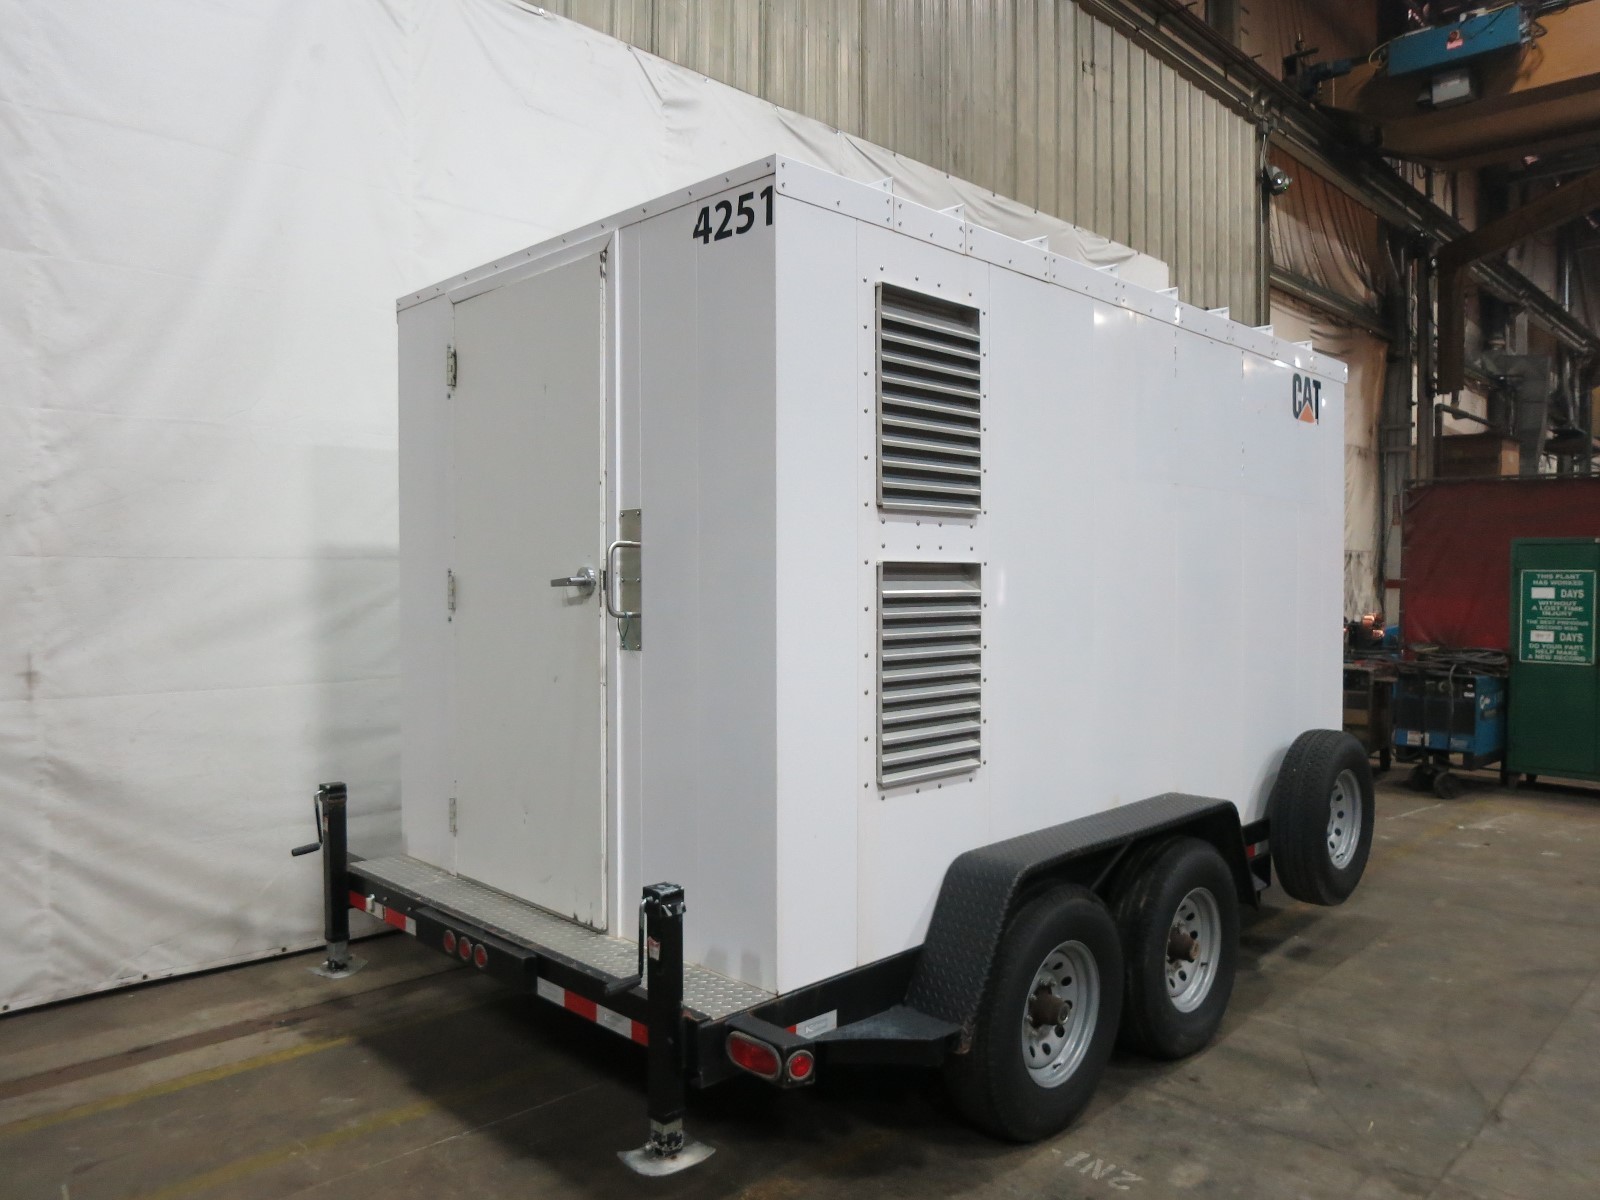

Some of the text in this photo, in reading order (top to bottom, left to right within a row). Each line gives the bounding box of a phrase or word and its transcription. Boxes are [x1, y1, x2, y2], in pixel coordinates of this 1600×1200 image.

[692, 185, 773, 245] 4251
[1292, 372, 1322, 420] CAT
[1560, 589, 1585, 599] DAYS
[1559, 632, 1584, 643] DAYS
